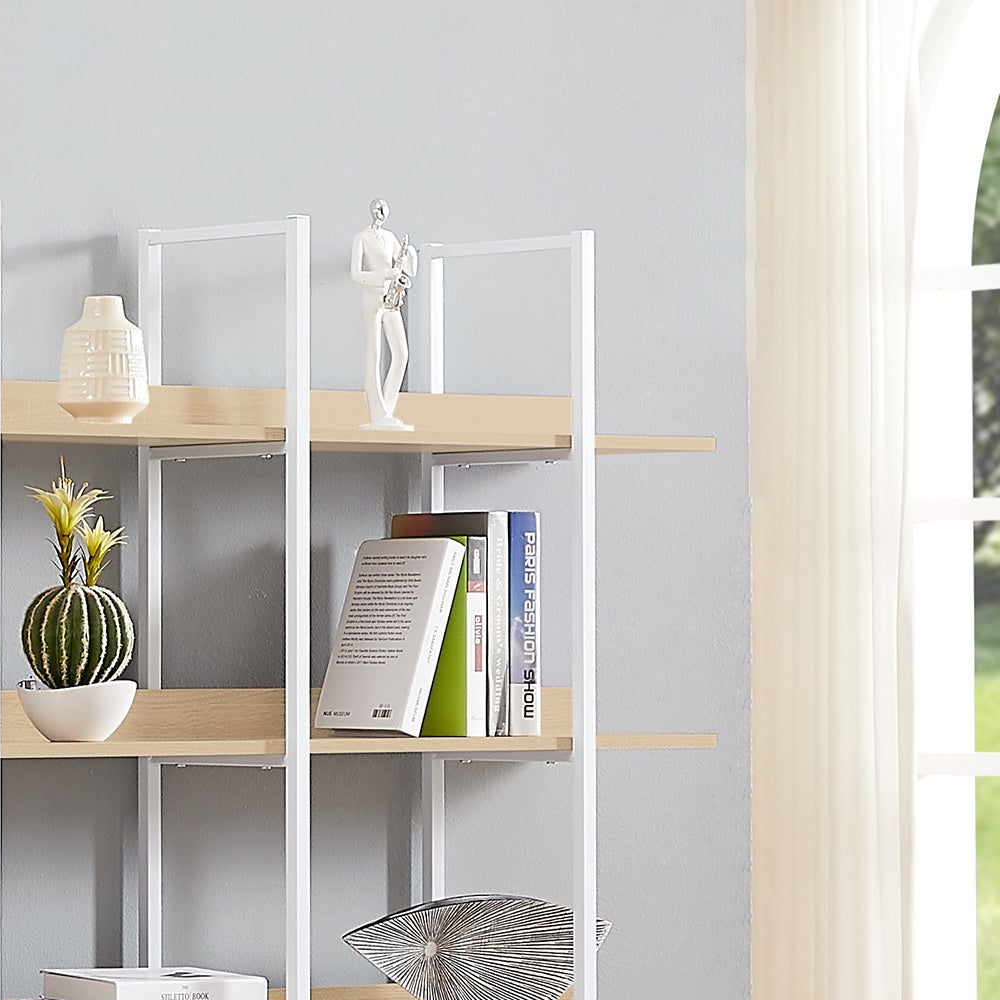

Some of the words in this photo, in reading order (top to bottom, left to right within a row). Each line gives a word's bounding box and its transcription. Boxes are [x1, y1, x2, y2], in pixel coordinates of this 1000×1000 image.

[474, 616, 482, 645] olivia
[494, 657, 503, 713] wedding
[160, 992, 190, 1000] STILETTO
[192, 992, 210, 1000] BOOK
